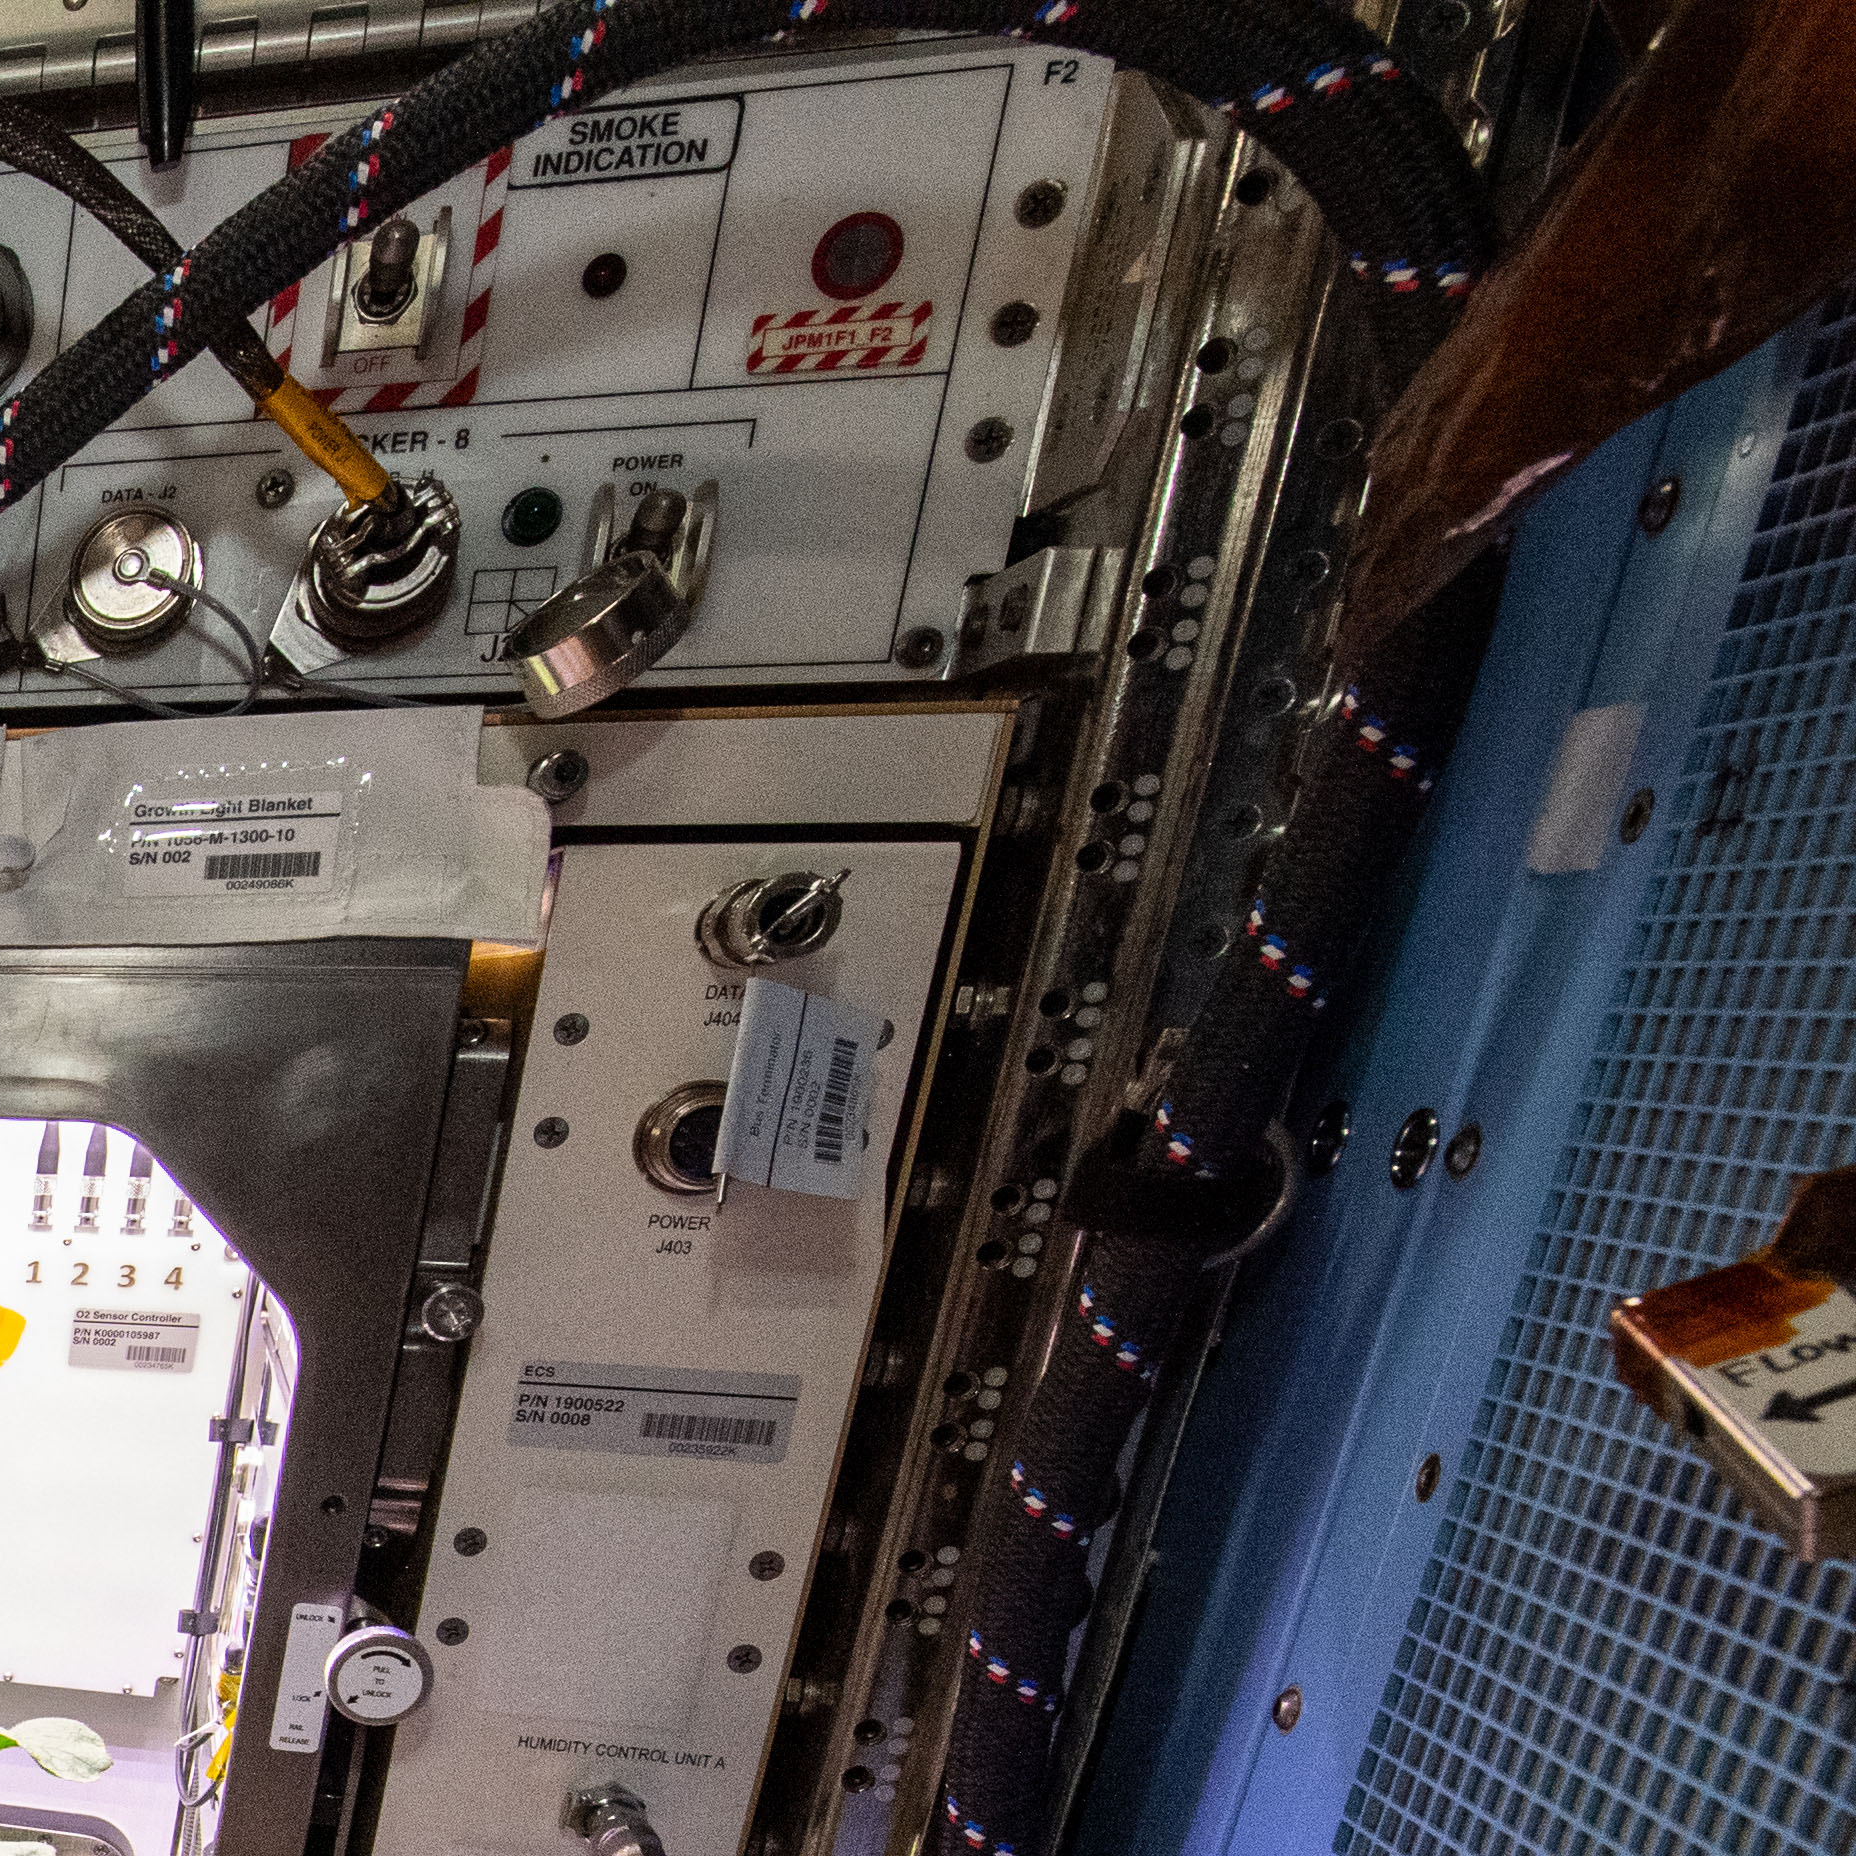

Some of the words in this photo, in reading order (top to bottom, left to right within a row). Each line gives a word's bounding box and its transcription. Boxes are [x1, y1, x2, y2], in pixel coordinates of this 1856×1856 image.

[1042, 59, 1080, 86] F2
[568, 112, 682, 147] SMOKE
[532, 138, 709, 178] INDICATION
[354, 355, 391, 375] OFF
[454, 428, 470, 450] 8
[613, 453, 685, 473] POWER
[101, 486, 144, 503] DATA
[248, 797, 314, 813] Blanket
[129, 851, 158, 866] S/N
[162, 851, 192, 864] 002
[704, 1011, 742, 1027] J404
[756, 1031, 781, 1105] Terminator
[749, 1109, 765, 1138] Bus
[648, 1213, 712, 1232] POWER
[655, 1239, 693, 1256] J403
[26, 1261, 42, 1284] 1
[70, 1261, 90, 1286] 2
[116, 1265, 136, 1288] 3
[163, 1266, 183, 1290] 4
[92, 1310, 129, 1322] Sensor
[131, 1312, 183, 1324] Controller
[523, 1364, 556, 1378] ECS
[1722, 1333, 1856, 1388] FLOW
[518, 1394, 549, 1408] P/N
[554, 1396, 625, 1413] 1900522
[515, 1409, 546, 1424] S/N
[549, 1412, 592, 1427] 0008
[517, 1735, 592, 1756] HUMIDITY
[594, 1742, 670, 1765] CONTROL
[673, 1751, 713, 1769] UNIT
[714, 1756, 726, 1770] A
